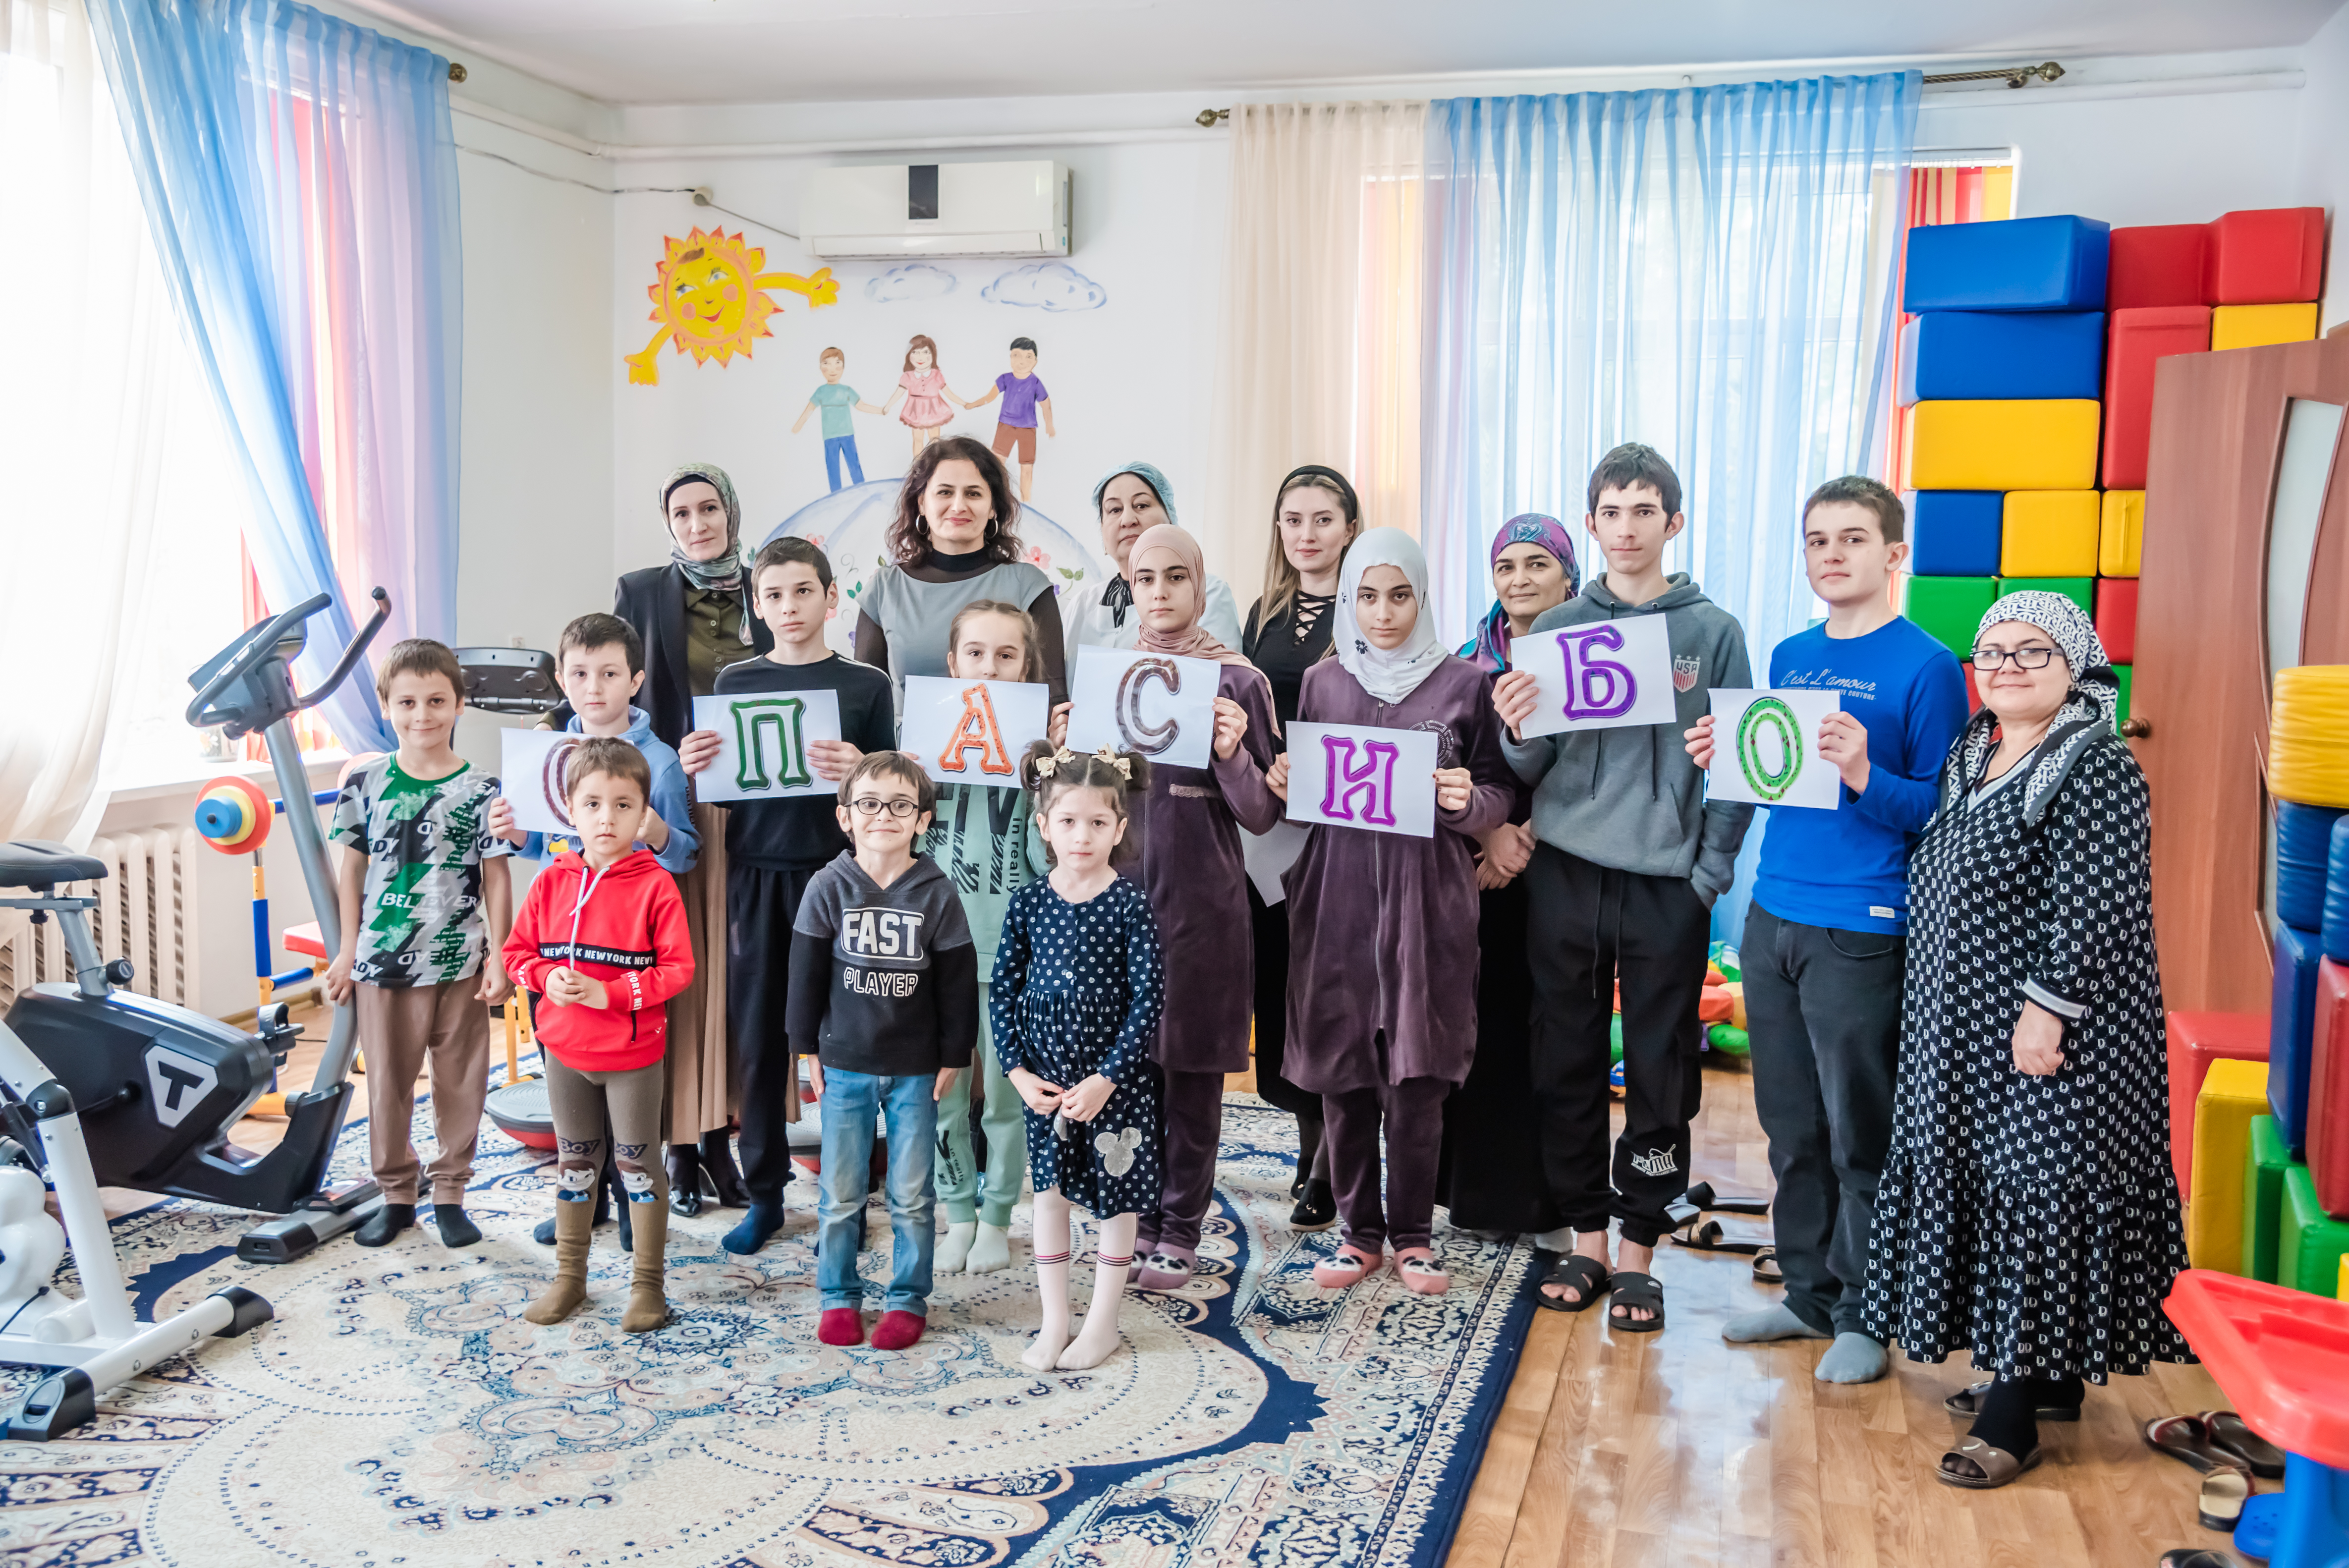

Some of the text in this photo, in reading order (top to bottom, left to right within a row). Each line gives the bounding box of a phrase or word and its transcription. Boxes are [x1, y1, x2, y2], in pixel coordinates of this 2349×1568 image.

[1556, 624, 1637, 721] Б
[1677, 662, 1697, 674] USA
[1781, 669, 1813, 686] C'est
[1809, 668, 1876, 692] L'amour
[728, 697, 813, 791] П
[1007, 818, 1022, 893] in really
[843, 911, 923, 956] FAST
[584, 949, 632, 965] NEWYORK
[843, 966, 919, 997] PLAYER
[158, 1060, 205, 1111] T
